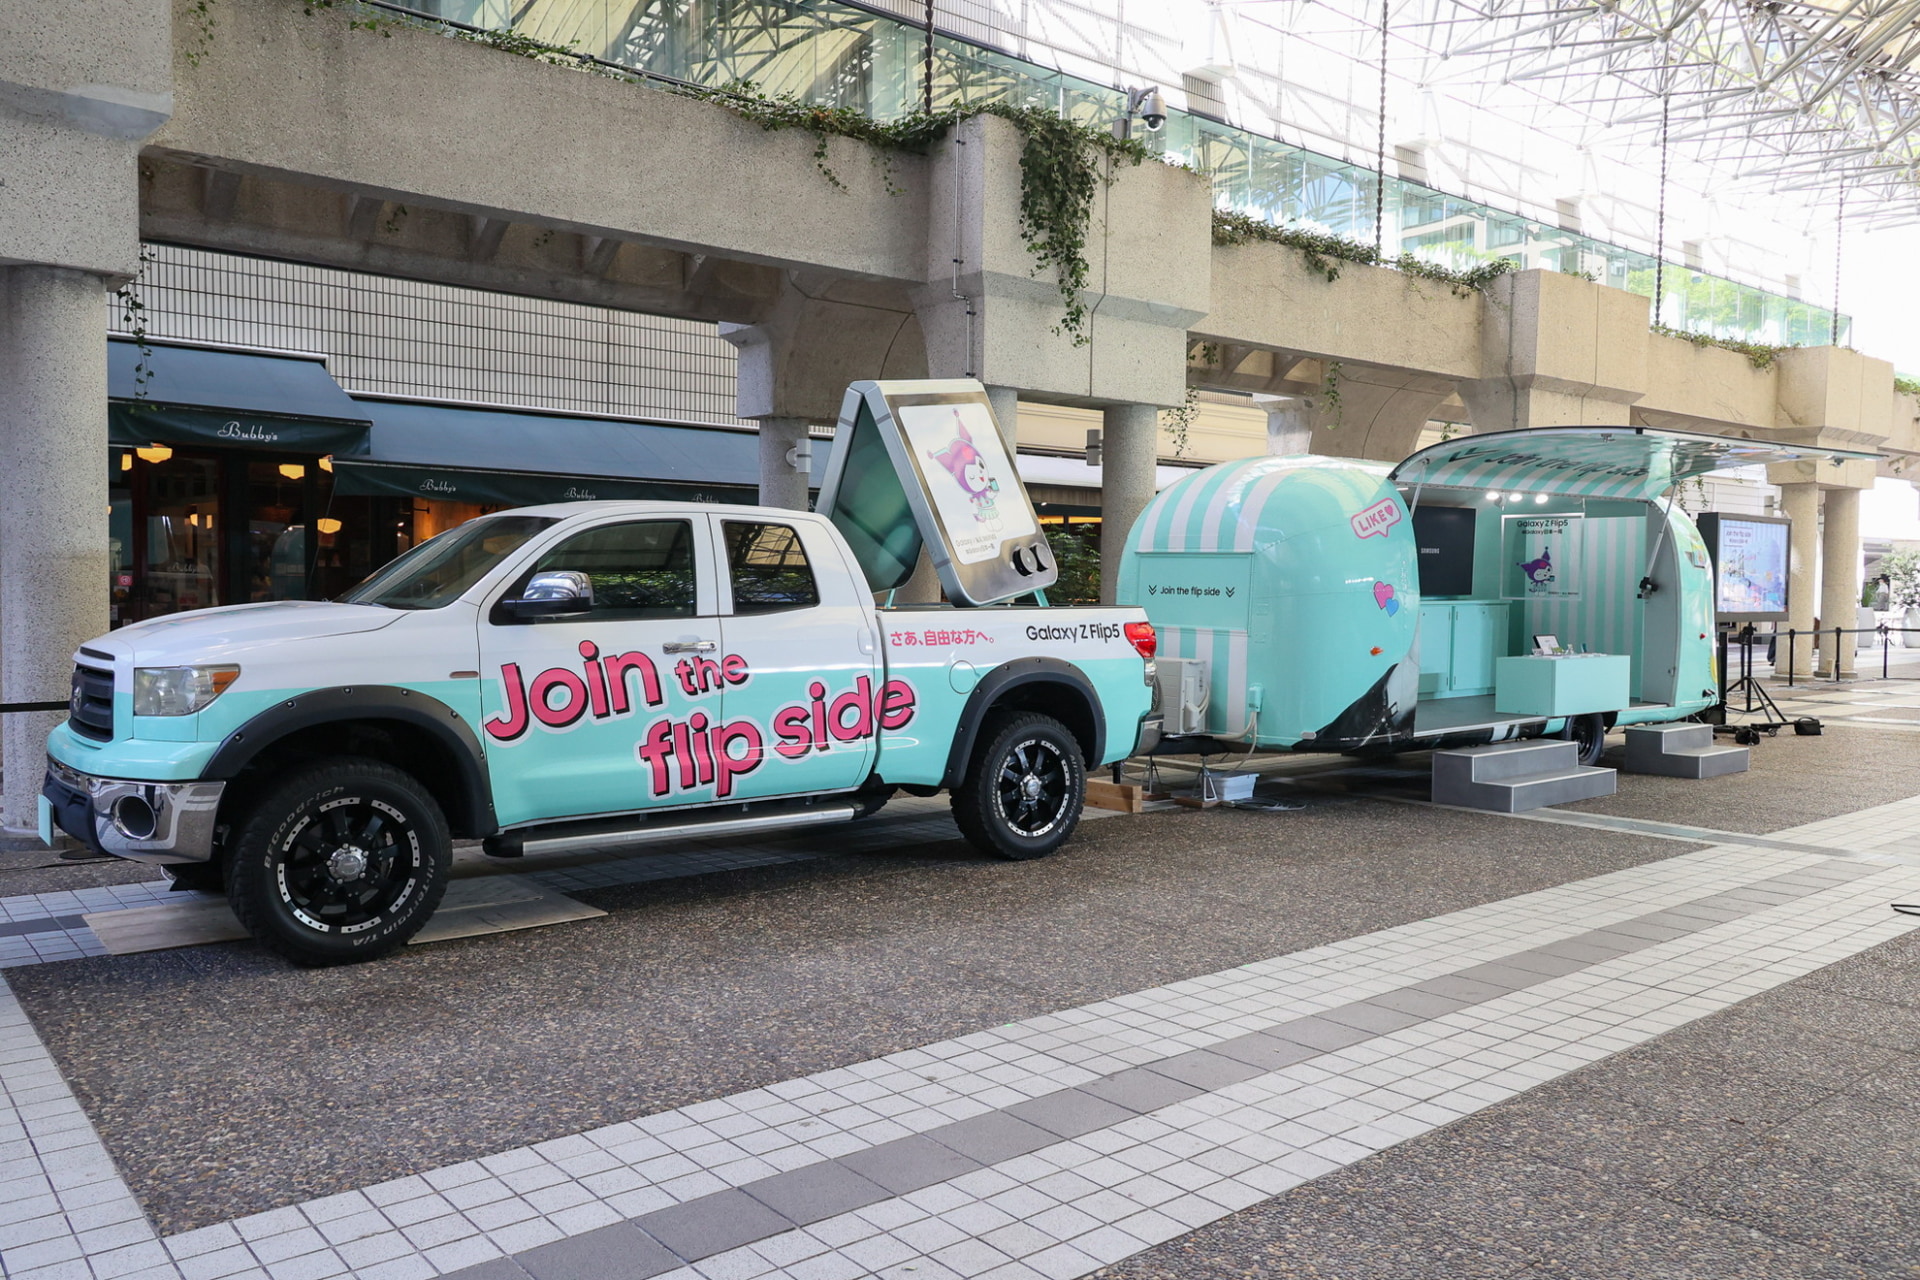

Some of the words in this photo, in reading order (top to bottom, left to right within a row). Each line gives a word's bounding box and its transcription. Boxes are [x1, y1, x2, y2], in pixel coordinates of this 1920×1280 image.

[217, 421, 278, 442] Bubby's
[419, 479, 457, 493] Bubby's
[1358, 510, 1387, 532] LIKE
[1517, 520, 1544, 528] Galaxy
[1551, 519, 1568, 527] Flip5
[1160, 586, 1175, 595] Join
[1177, 586, 1189, 595] the
[1191, 586, 1203, 598] flip
[1204, 587, 1221, 596] side
[890, 629, 994, 647] さあ、自由な方へ。
[1026, 625, 1077, 643] Galaxy
[1080, 625, 1088, 639] Z
[1090, 623, 1120, 643] Flip5
[484, 640, 663, 742] Join
[673, 653, 749, 697] the
[638, 712, 764, 798] flip
[773, 675, 916, 759] side
[264, 786, 345, 869] BFGoodrich
[383, 855, 436, 935] All-Terrain
[353, 934, 379, 947] T/A
